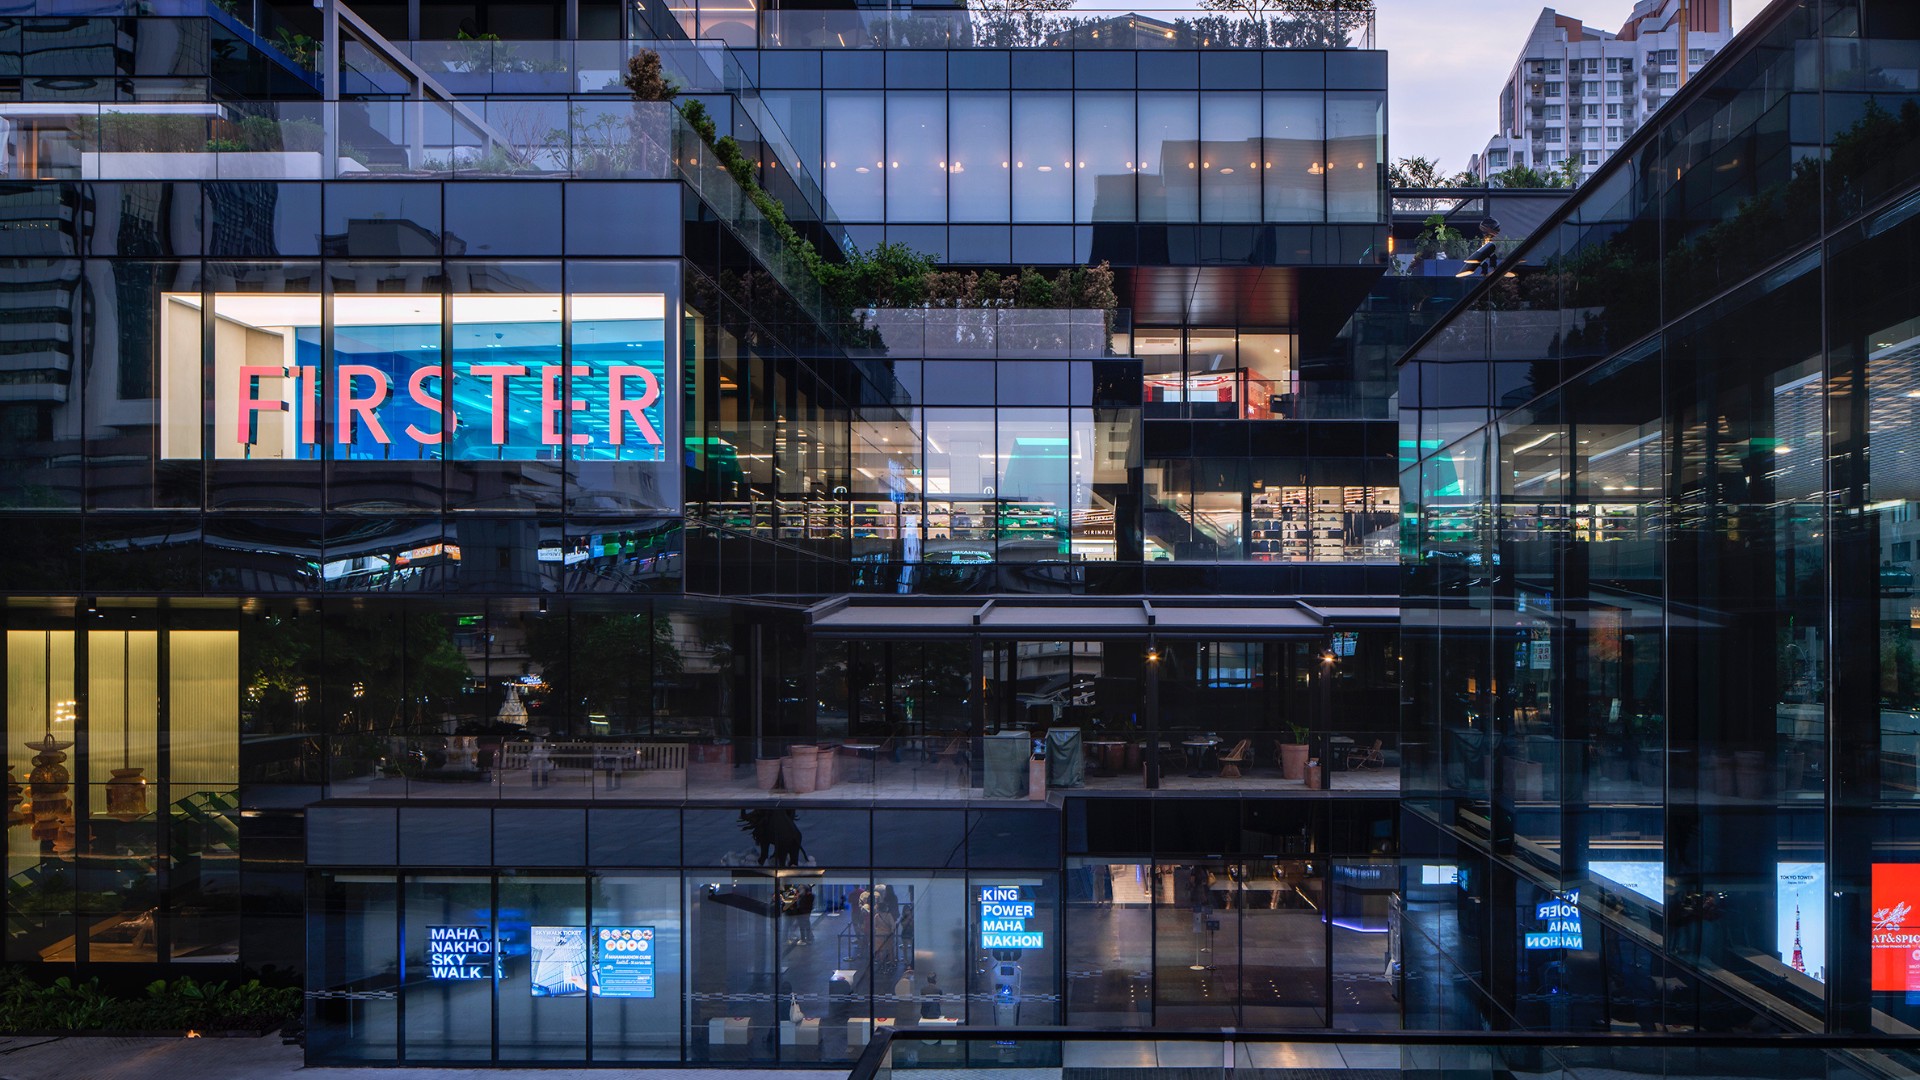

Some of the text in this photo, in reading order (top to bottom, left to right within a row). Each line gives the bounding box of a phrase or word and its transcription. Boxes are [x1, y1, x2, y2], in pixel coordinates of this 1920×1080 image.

[237, 365, 662, 445] FIRSTER
[983, 889, 1018, 901] KING
[983, 905, 1033, 916] POWER
[983, 921, 1023, 932] MAHA
[431, 928, 480, 940] MAHA
[983, 936, 1042, 947] NAKHON
[431, 954, 467, 966] SKY
[432, 966, 482, 979] WALK
